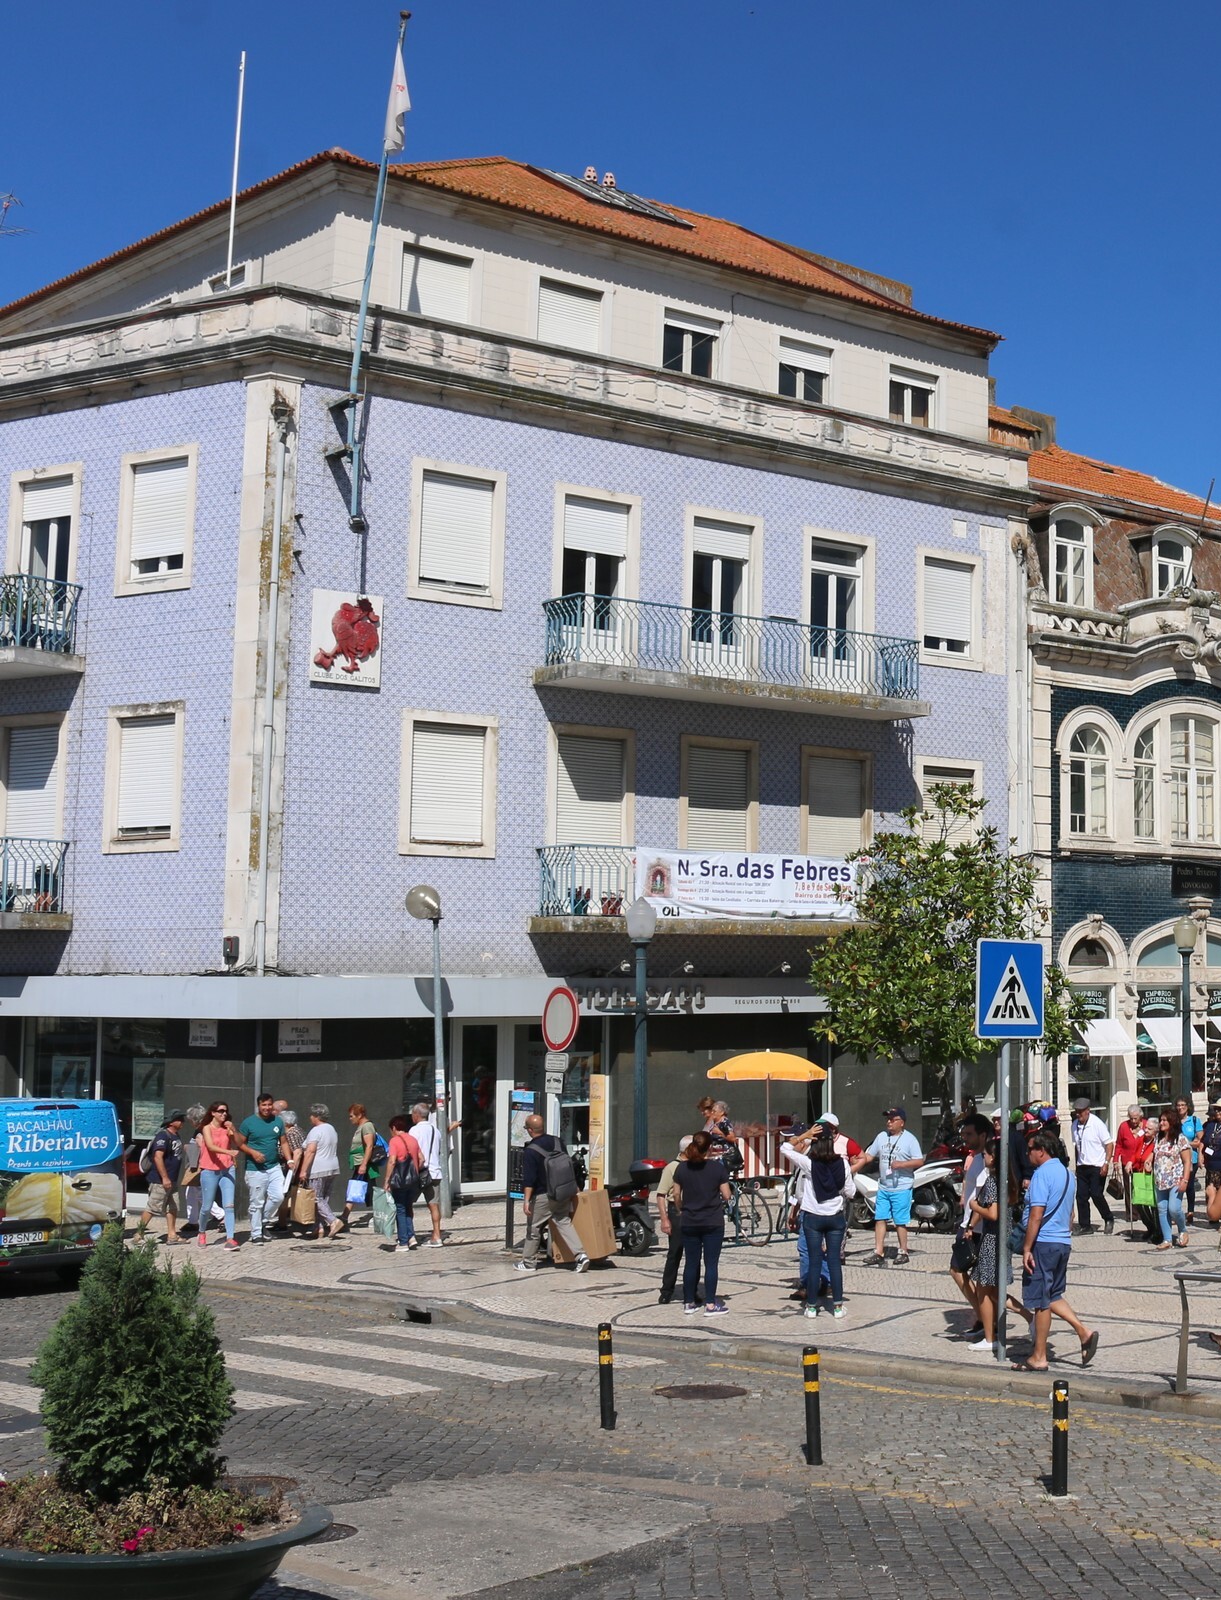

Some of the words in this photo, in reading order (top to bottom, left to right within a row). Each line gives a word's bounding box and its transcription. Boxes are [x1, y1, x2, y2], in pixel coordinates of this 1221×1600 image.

[350, 676, 376, 684] GALITOS
[678, 859, 694, 876] N.
[700, 860, 733, 878] Sra.
[736, 857, 774, 879] das
[782, 859, 851, 882] Febres
[1141, 997, 1176, 1005] AVEIRENSE
[6, 1132, 108, 1154] Riberalves
[3, 1234, 14, 1244] 82
[16, 1233, 30, 1242] SN
[32, 1232, 43, 1241] 20
